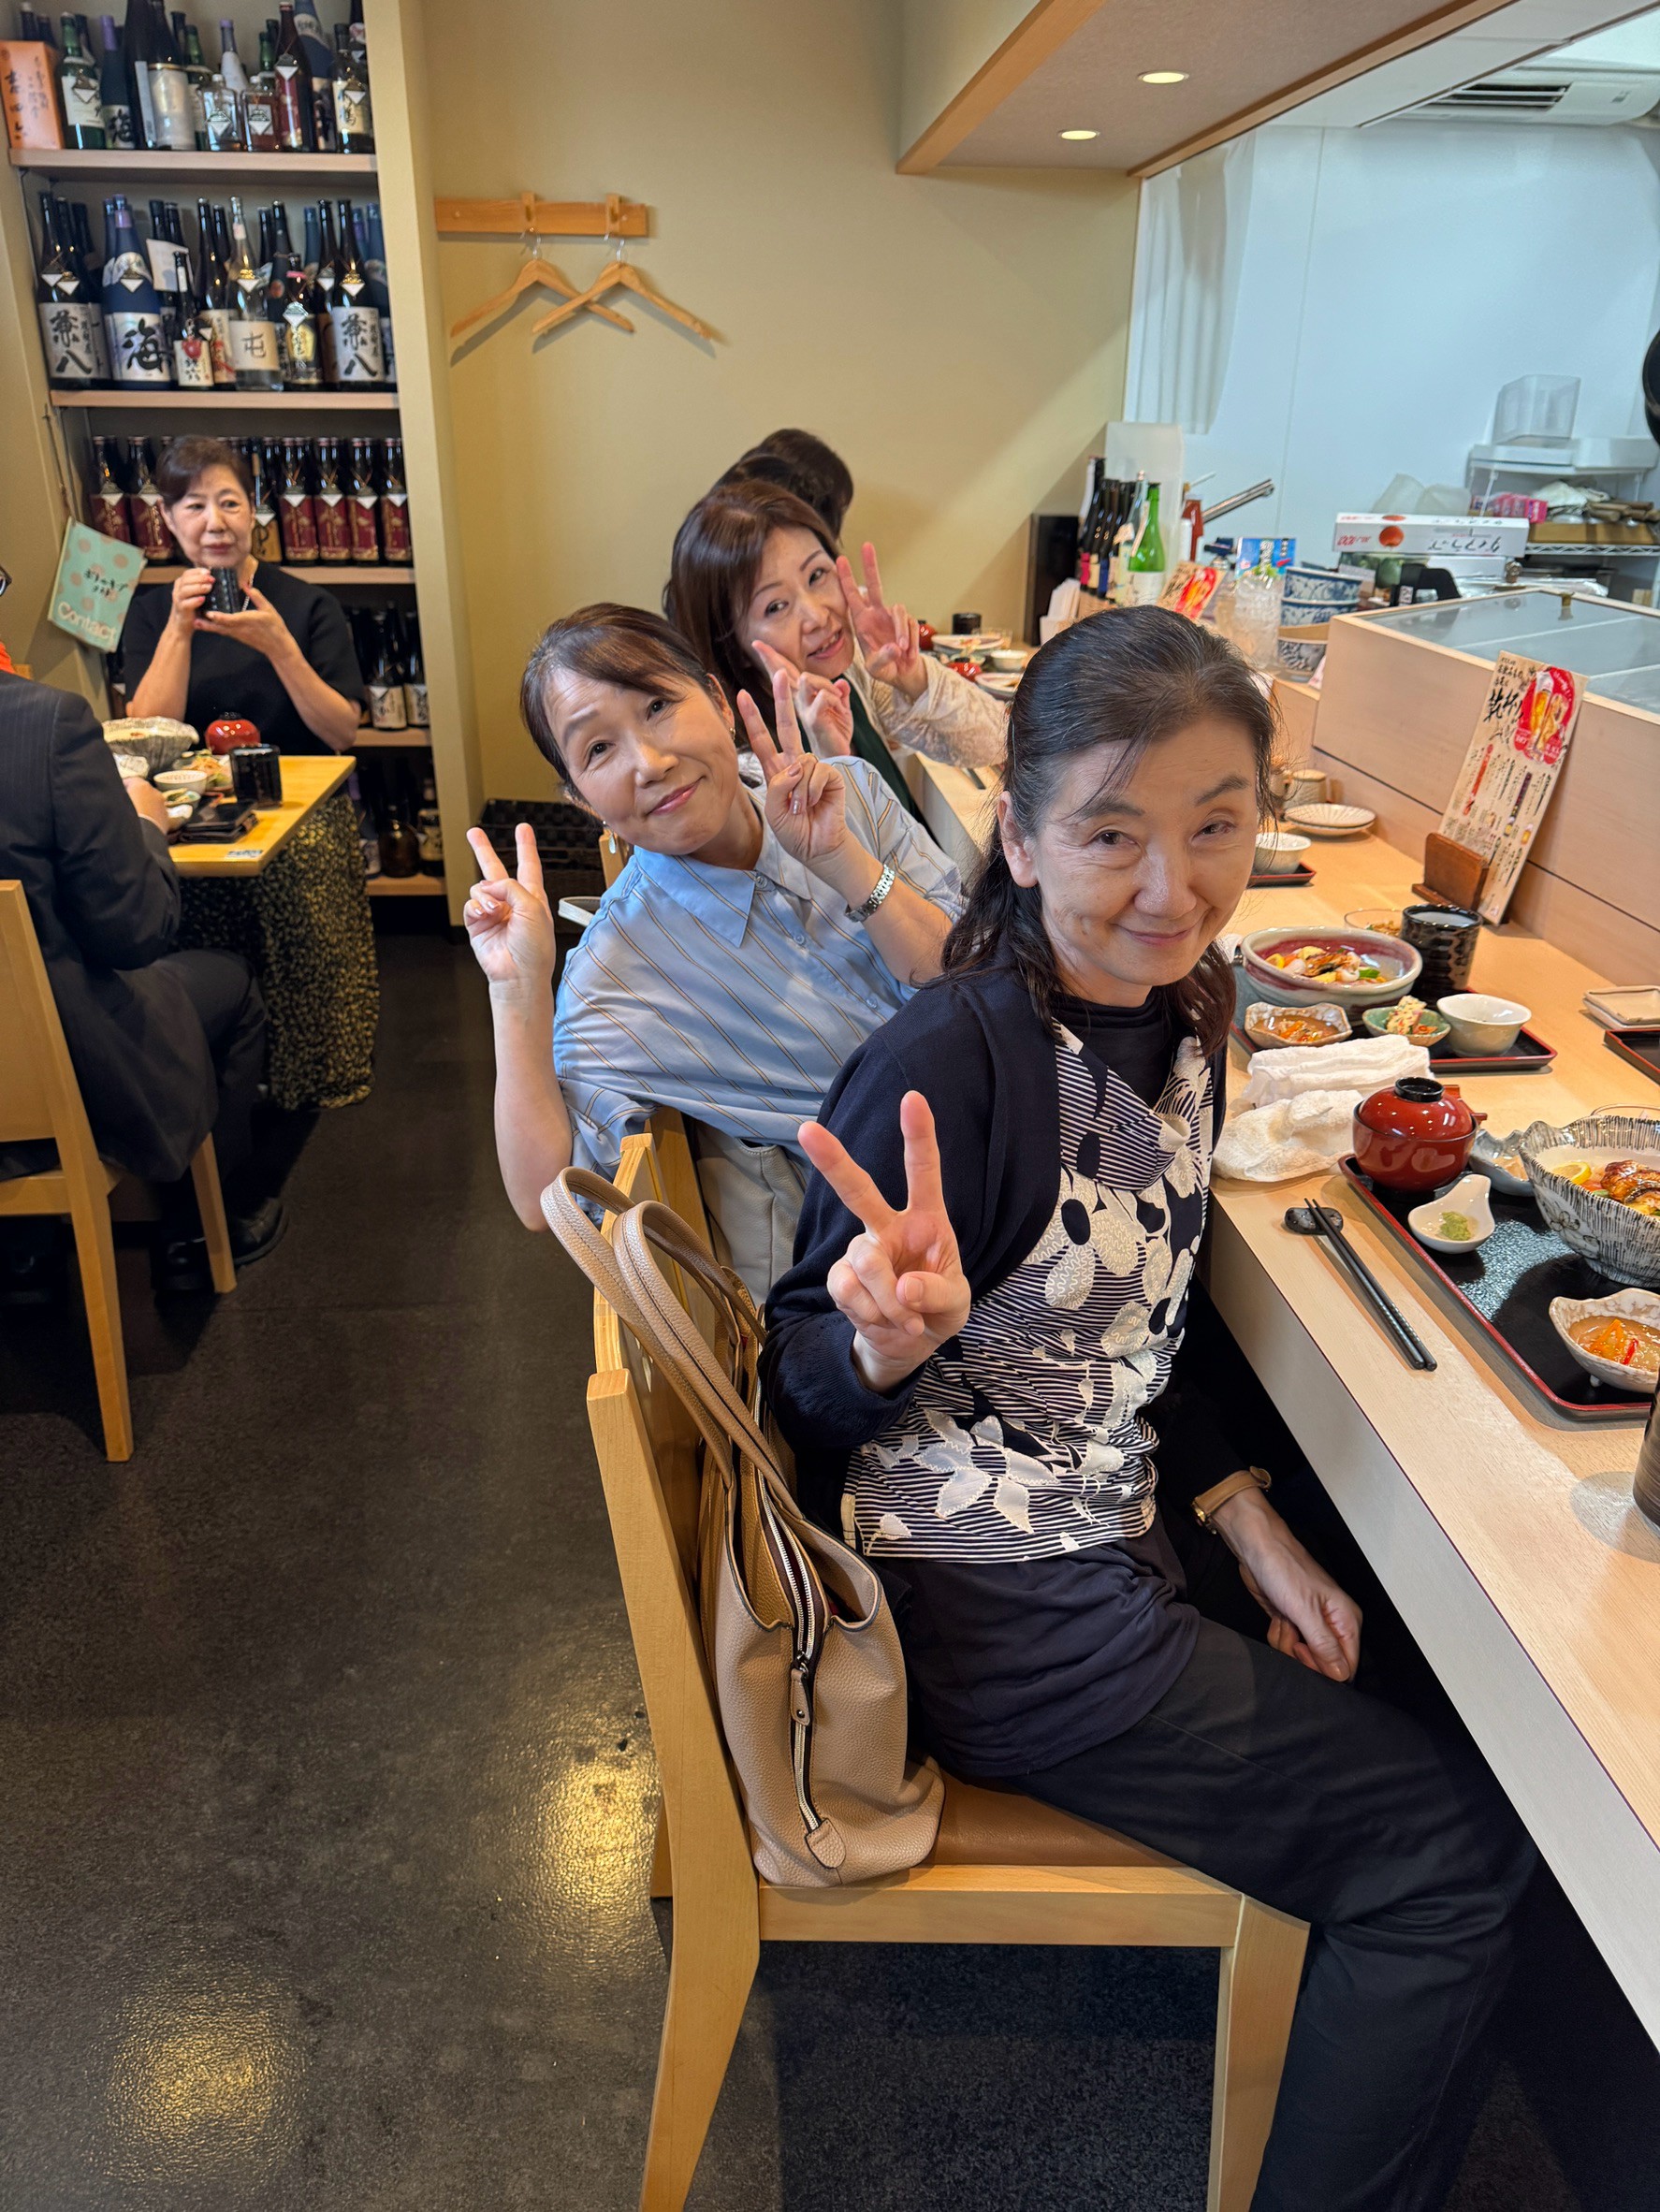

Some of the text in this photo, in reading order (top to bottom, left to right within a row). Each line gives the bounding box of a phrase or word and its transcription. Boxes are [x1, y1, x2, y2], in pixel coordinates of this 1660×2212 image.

[50, 309, 92, 374] 兼八
[122, 317, 165, 373] 海
[240, 330, 267, 358] 屯
[342, 313, 377, 376] 兼八
[58, 601, 116, 644] Contact
